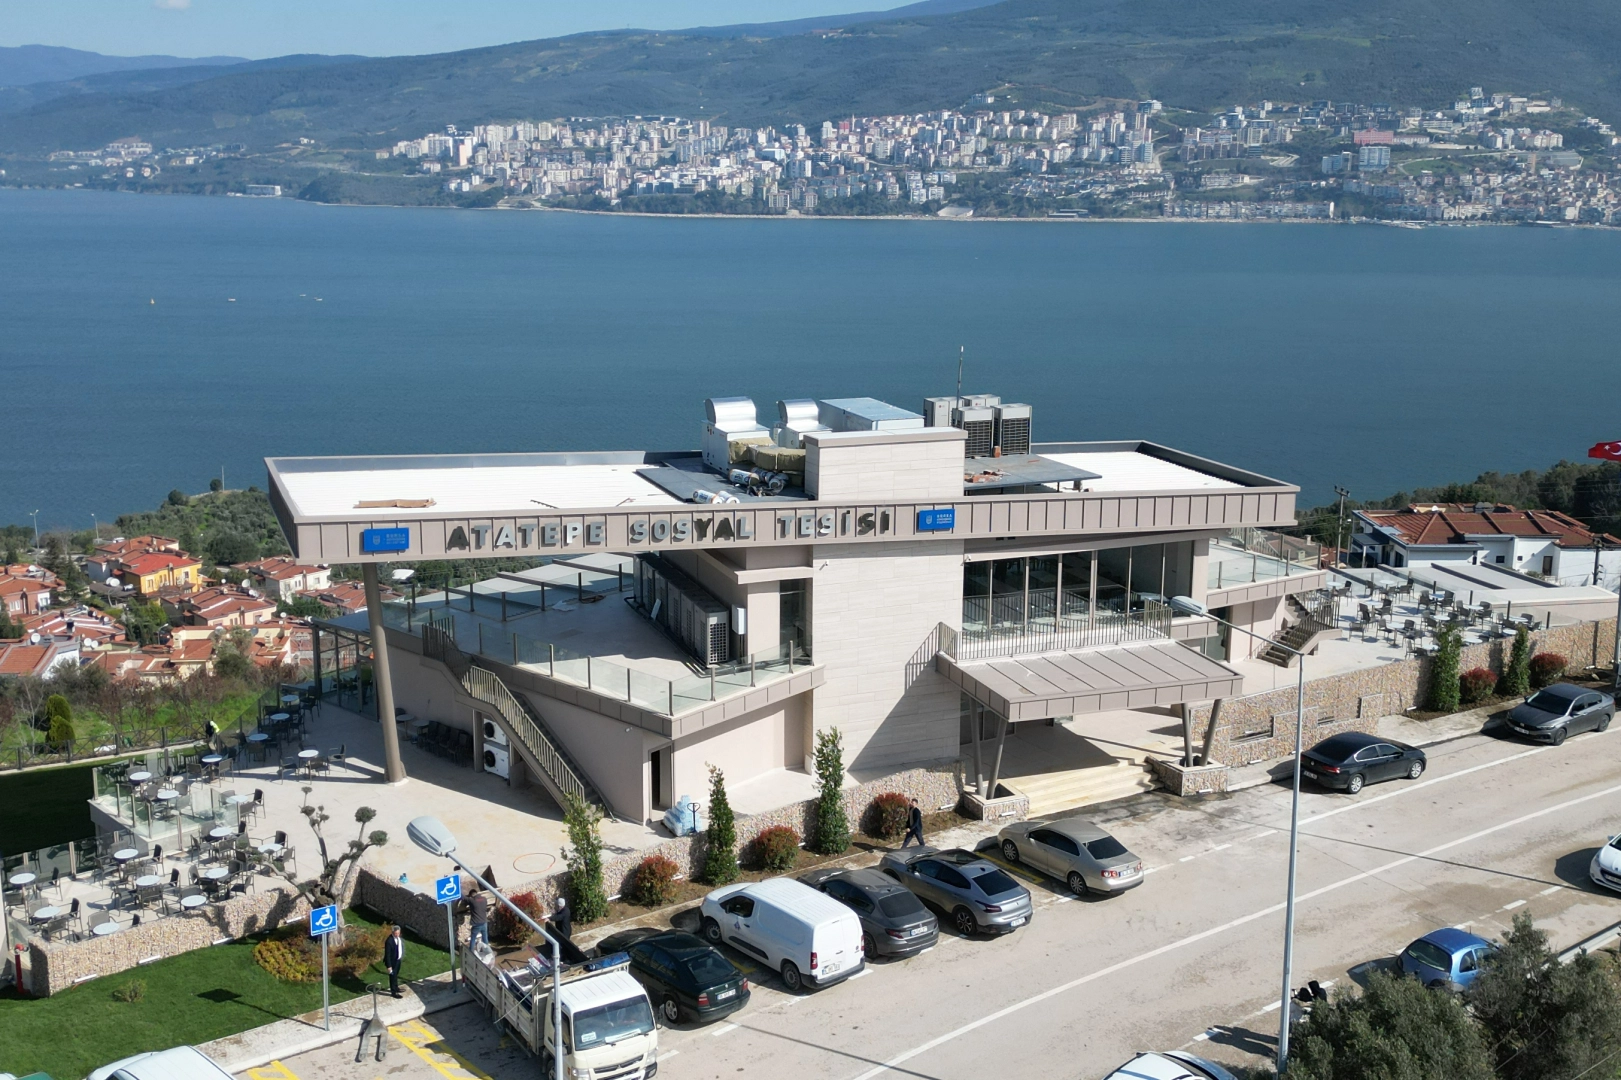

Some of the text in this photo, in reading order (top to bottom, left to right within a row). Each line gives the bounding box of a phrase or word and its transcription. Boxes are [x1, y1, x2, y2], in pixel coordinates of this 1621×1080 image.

[448, 508, 890, 549] ATATEPE SOSYAL TESİSİ
